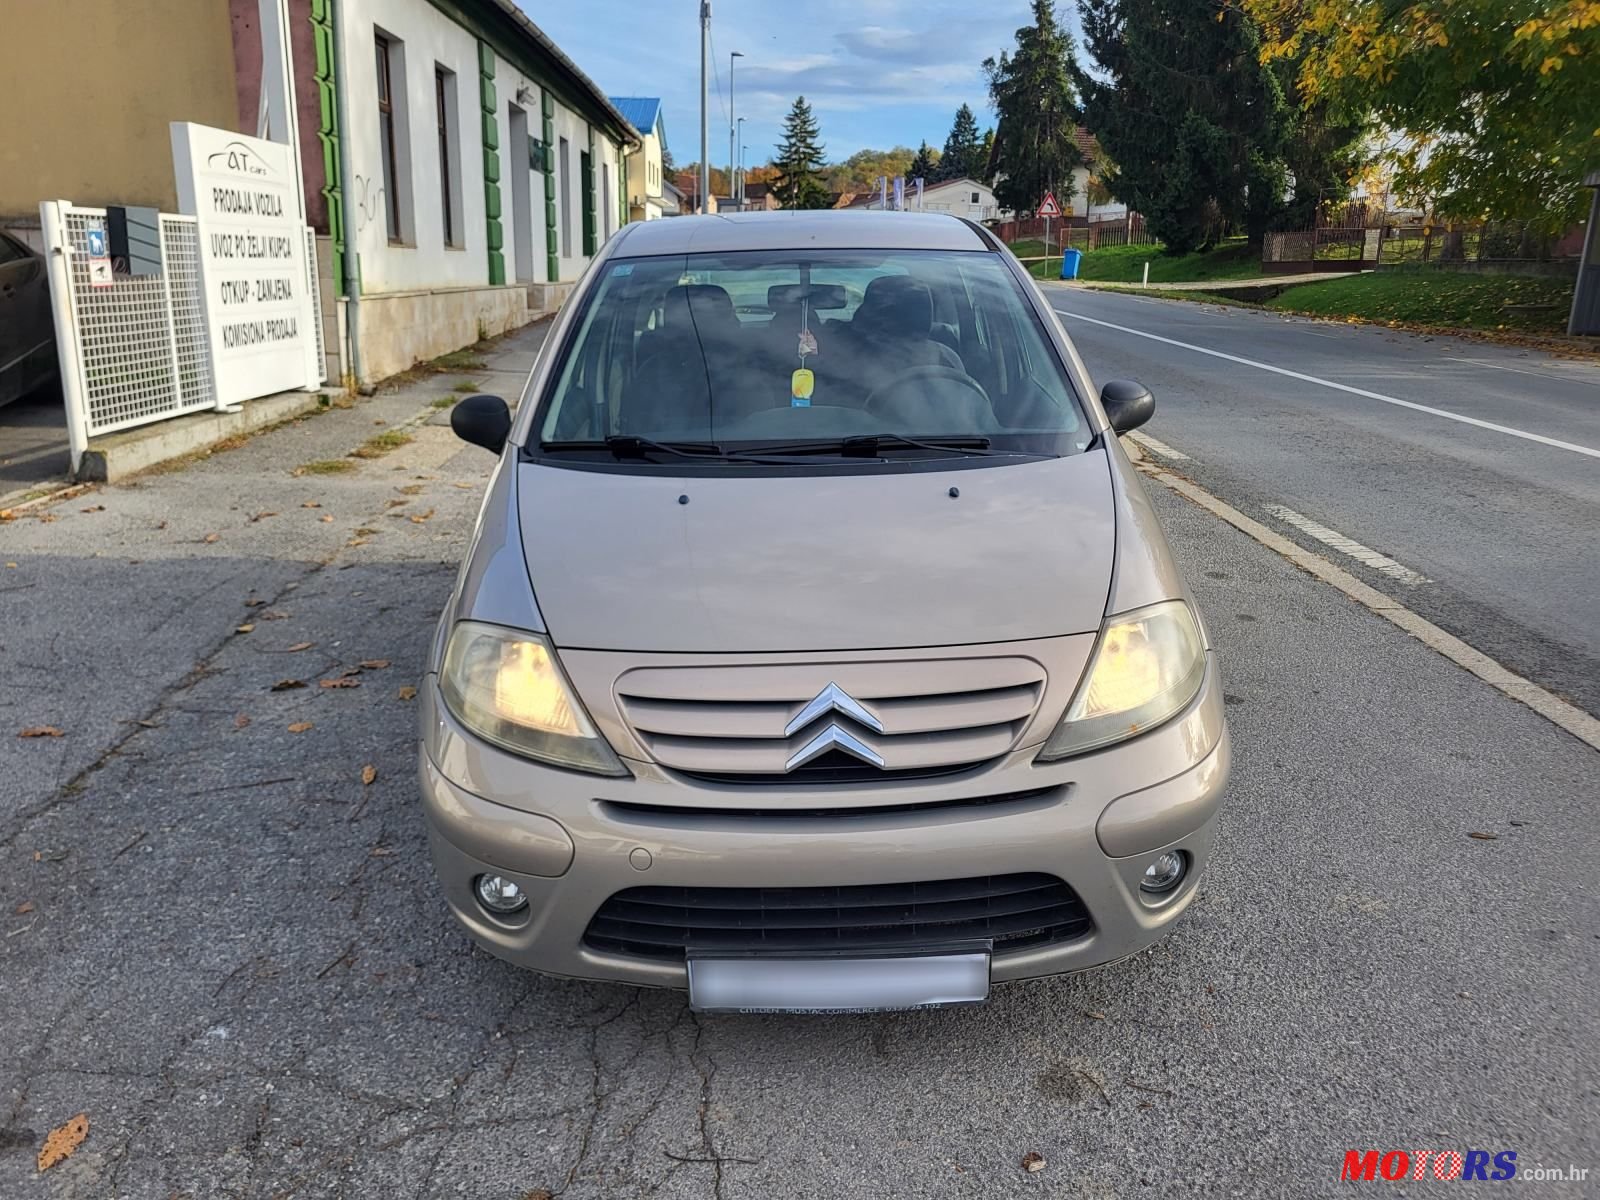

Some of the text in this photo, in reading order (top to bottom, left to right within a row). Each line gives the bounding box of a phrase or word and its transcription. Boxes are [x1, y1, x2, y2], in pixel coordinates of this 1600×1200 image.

[213, 187, 284, 217] PRODAJA VOZILA
[210, 229, 292, 259] UVOZ PO ŽELJI KUPCA
[221, 280, 249, 305] OTKUP
[256, 277, 293, 302] ZAMJENA
[222, 316, 299, 349] KOMISIONA PRODAJA
